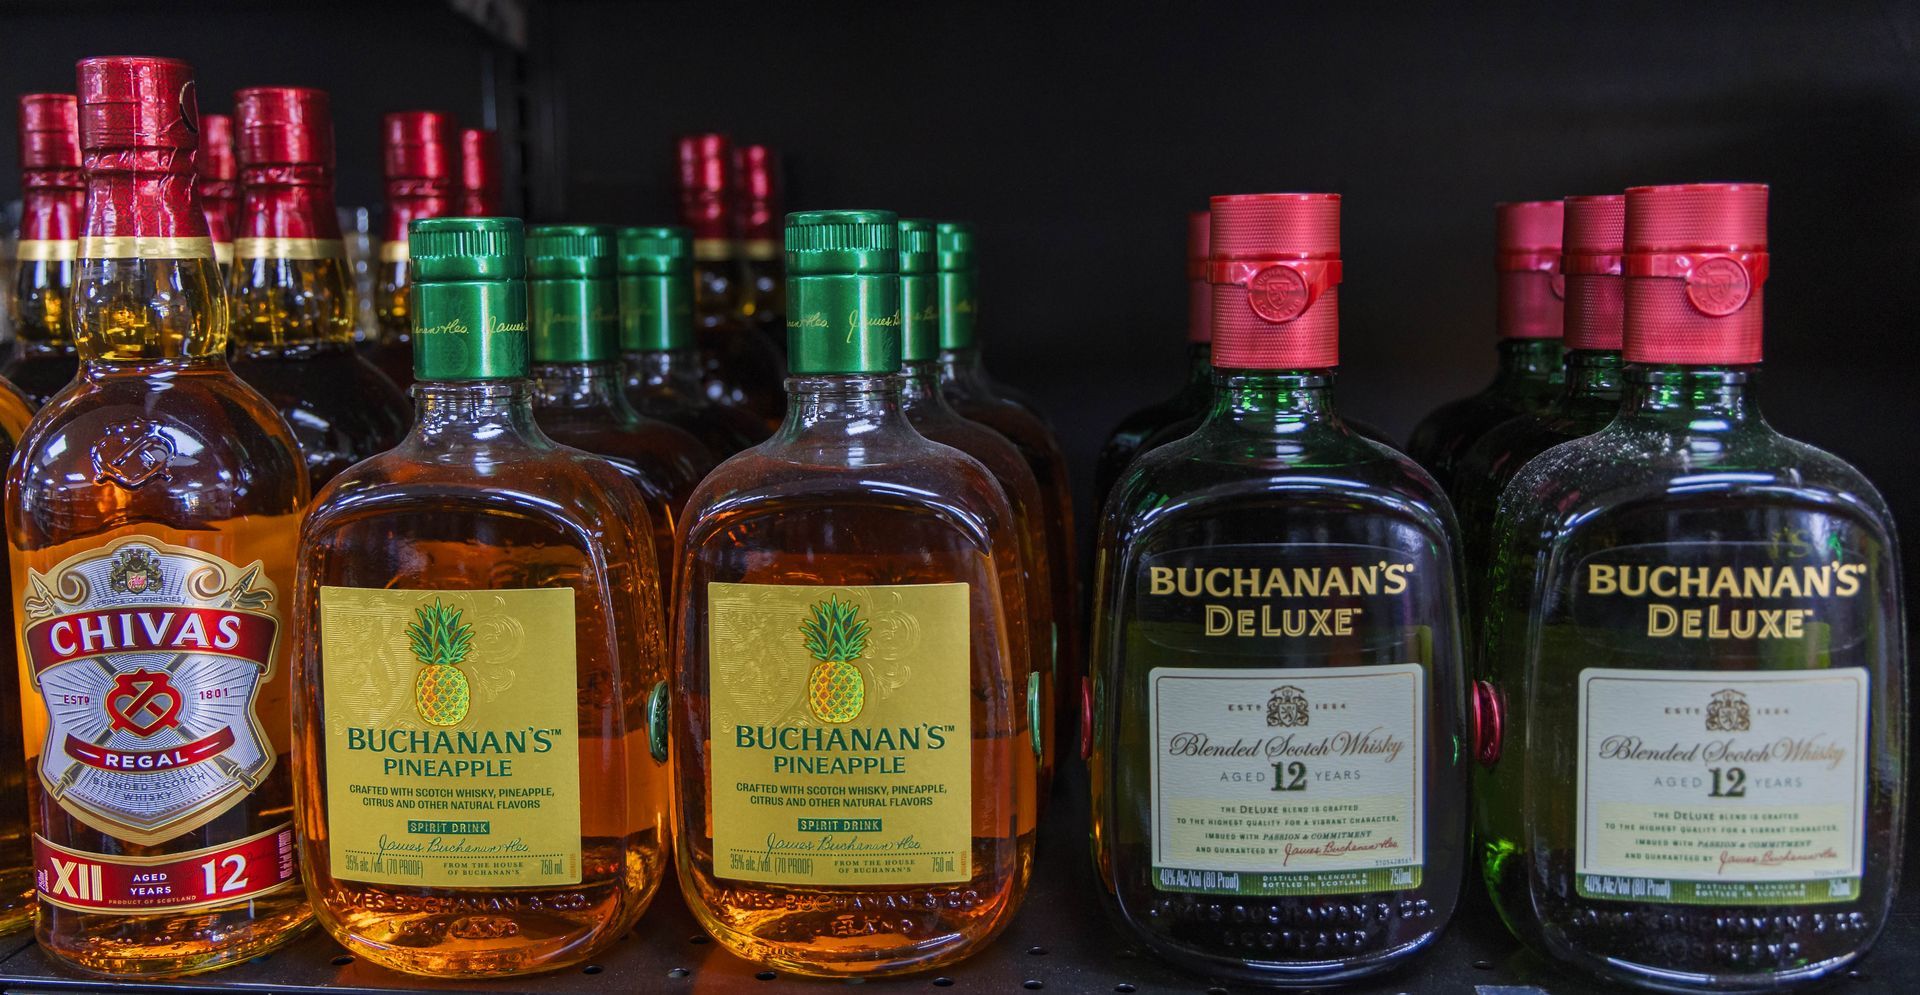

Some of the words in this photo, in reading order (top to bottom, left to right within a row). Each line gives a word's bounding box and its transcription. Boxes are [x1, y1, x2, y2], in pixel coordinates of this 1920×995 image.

[50, 612, 241, 656] CHIVAS
[199, 688, 229, 700] 1801
[1169, 731, 1263, 757] Blended
[1264, 733, 1329, 761] Scotch
[1330, 727, 1404, 763] Whisky
[1598, 735, 1700, 762] Blended
[1701, 737, 1771, 766] Scotch
[1770, 732, 1847, 771] Whisky
[105, 751, 189, 769] REGAL
[384, 758, 513, 777] PINEAPPLE
[773, 755, 906, 774] PINEAPPLE
[93, 776, 149, 791] BLENDED
[154, 772, 206, 789] SCOTCH
[1219, 771, 1265, 782] AGED
[1270, 761, 1308, 792] 12
[1315, 770, 1362, 782] YEARS
[1653, 776, 1703, 788] AGED
[1707, 766, 1747, 798] 12
[1754, 776, 1804, 788] YEARS
[124, 791, 172, 801] WHISKY
[349, 784, 388, 796] CRAFTED
[390, 787, 413, 796] WITH
[415, 788, 453, 798] SCOTCH
[455, 788, 496, 799] WHISKY,
[498, 787, 555, 797] PINEAPPLE,
[736, 782, 778, 794] CRAFTED
[779, 785, 805, 795] WITH
[806, 786, 846, 796] SCOTCH
[848, 785, 889, 796] WHISKY,
[891, 784, 947, 795] PINEAPPLE,
[362, 797, 394, 807] CITRUS
[395, 799, 416, 809] AND
[417, 800, 448, 810] OTHER
[450, 800, 494, 810] NATURAL
[497, 799, 541, 809] FLAVORS
[750, 795, 784, 806] CITRUS
[785, 797, 807, 807] AND
[808, 797, 840, 807] OTHER
[842, 798, 887, 808] NATURAL
[889, 796, 933, 807] FLAVORS
[1322, 804, 1359, 812] CRAFTED
[1653, 811, 1669, 819] THE
[410, 822, 447, 833] SPIRIT
[451, 822, 487, 833] DRINK
[800, 820, 839, 831] SPIRIT
[843, 820, 879, 831] DRINK
[1605, 822, 1616, 830] TO
[1619, 823, 1636, 831] THE
[1680, 826, 1716, 834] QUALITY
[1205, 832, 1236, 840] IMBUED
[1263, 832, 1300, 840] PASSION
[1310, 830, 1372, 840] COMMITMENT
[378, 834, 423, 864] James
[427, 836, 501, 853] Buchanan
[766, 832, 814, 861] James
[817, 834, 893, 851] Buchanan
[1214, 847, 1266, 855] GUARANTEED
[1697, 840, 1737, 848] PASSION
[1748, 840, 1812, 848] COMMITMENT
[1624, 852, 1642, 860] AND
[1645, 853, 1700, 861] GUARANTEED
[345, 854, 359, 872] 35%
[386, 858, 398, 876] (70
[399, 859, 424, 879] PROOF)
[540, 859, 553, 875] 750
[730, 853, 745, 871] 35%
[774, 857, 786, 876] (70
[787, 858, 814, 878] PROOF)
[931, 856, 944, 873] 750
[50, 857, 103, 901] XII
[133, 873, 167, 882] AGED
[202, 854, 249, 895] 12
[1160, 868, 1176, 886] 40%
[1203, 871, 1216, 891] (80
[1217, 872, 1239, 892] Proof)
[1317, 873, 1357, 881] BLENDED
[130, 886, 172, 895] YEARS
[1262, 881, 1302, 889] BOTTLED
[1320, 878, 1368, 888] SCOTLAND
[1584, 875, 1601, 893] 40%
[1631, 878, 1646, 899] (80
[1647, 878, 1671, 900] Proof)
[156, 895, 197, 904] SCOTLAND
